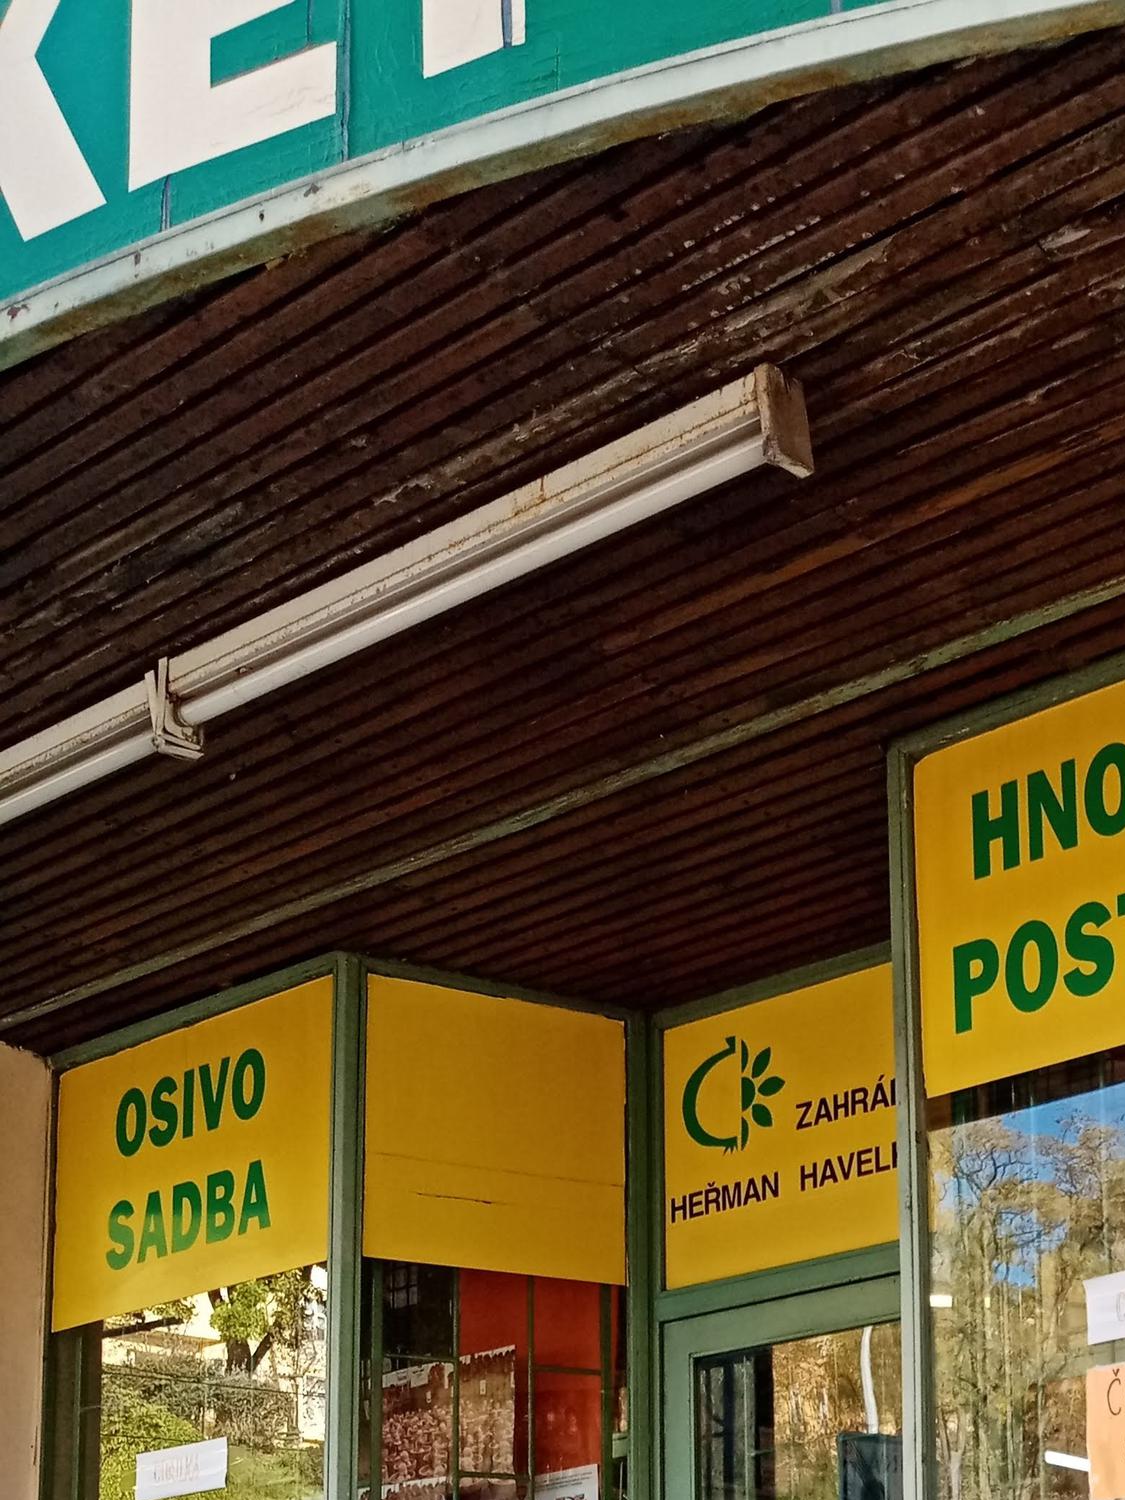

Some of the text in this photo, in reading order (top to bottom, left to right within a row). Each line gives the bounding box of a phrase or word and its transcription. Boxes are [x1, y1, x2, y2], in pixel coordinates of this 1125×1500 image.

[116, 1048, 265, 1157] OSIVO
[796, 1075, 897, 1130] ZAHRÁ
[106, 1159, 271, 1270] SADBA
[671, 1142, 898, 1224] HEŘMAN HAVEL
